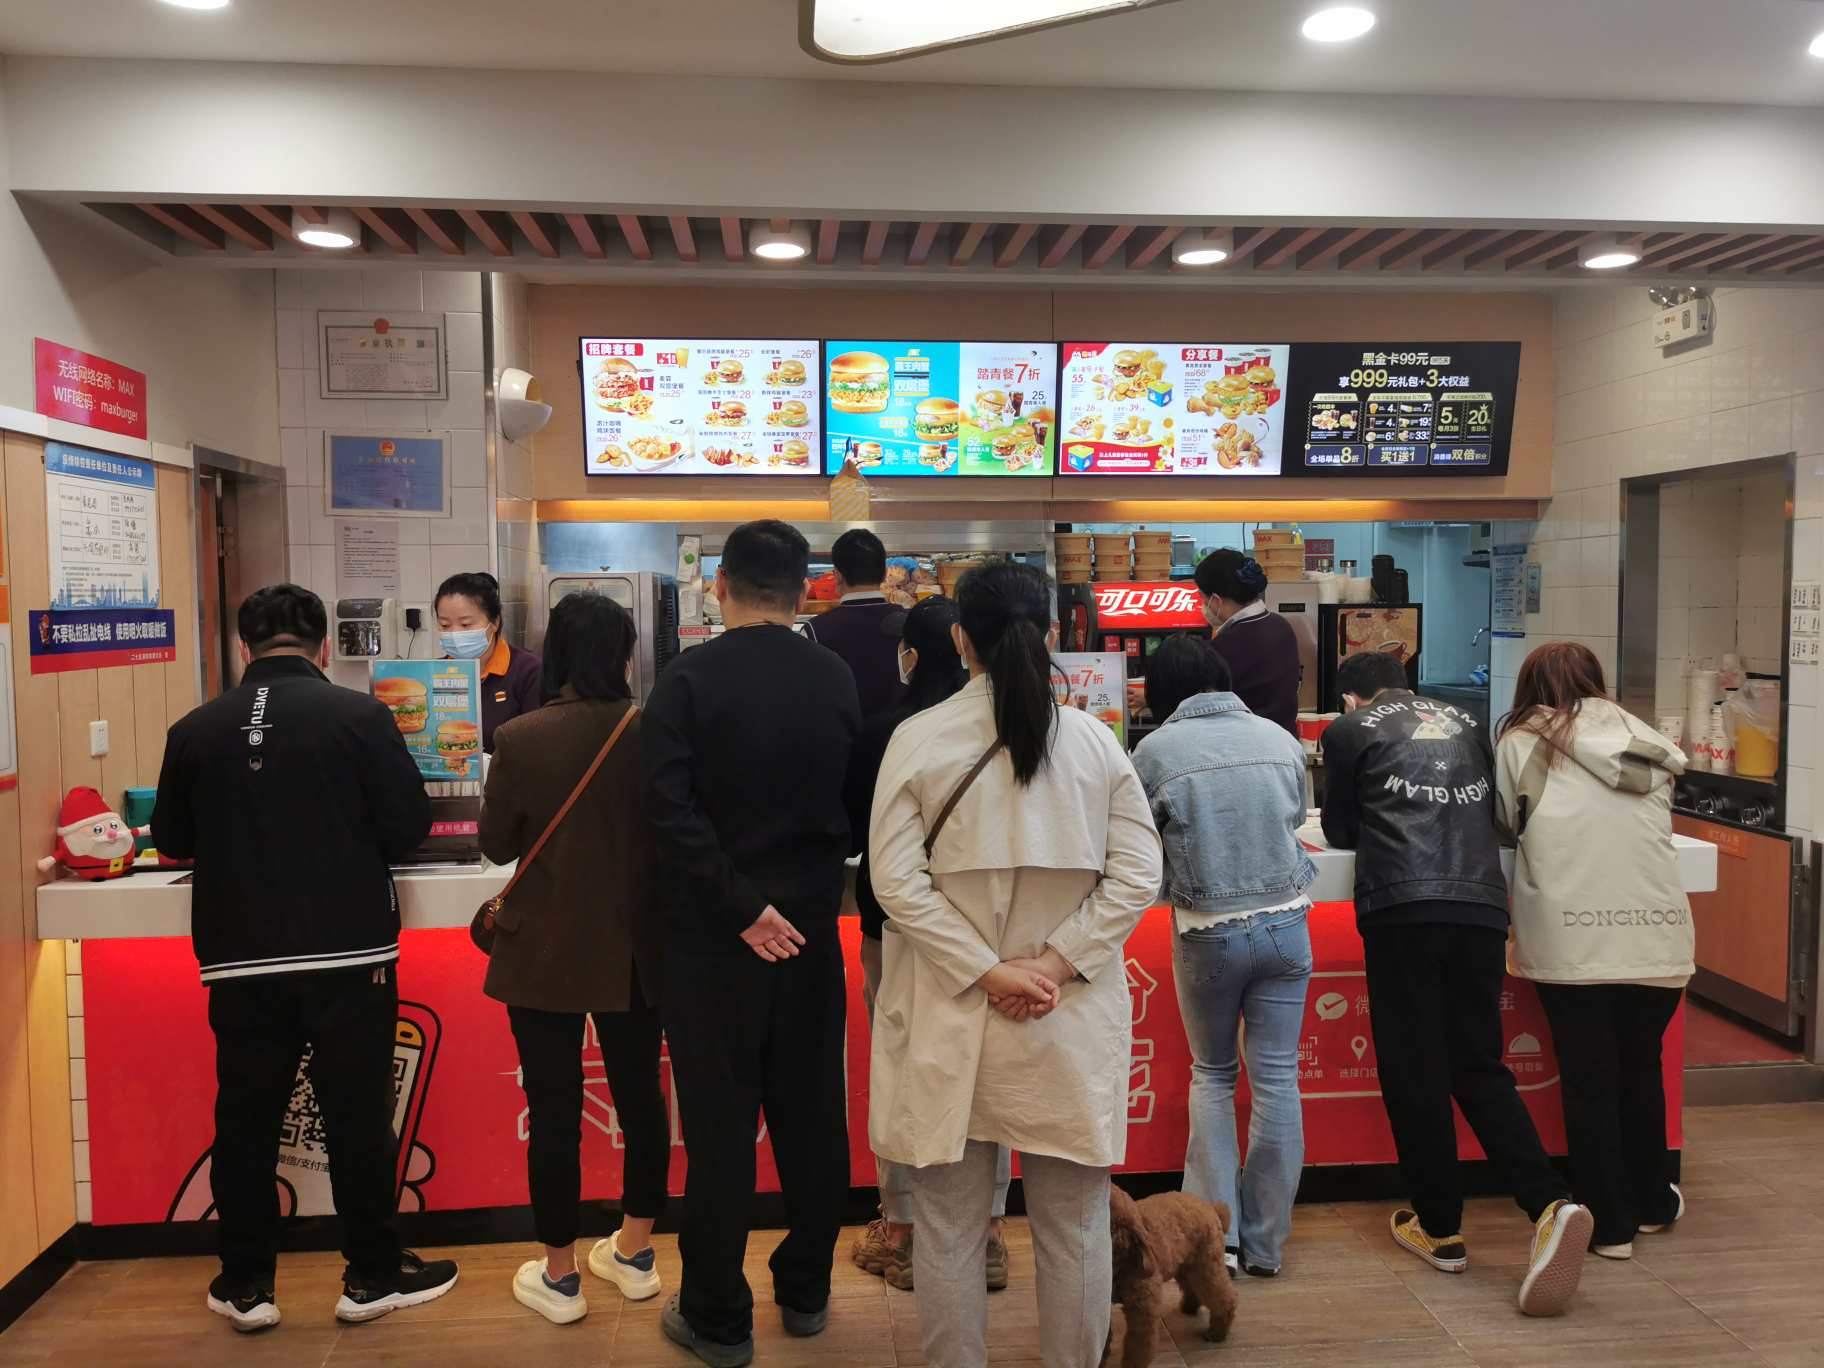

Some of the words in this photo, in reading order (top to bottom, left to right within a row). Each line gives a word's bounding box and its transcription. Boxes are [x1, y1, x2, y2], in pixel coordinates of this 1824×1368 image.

[1185, 349, 1219, 361] 分享餐
[1362, 352, 1428, 366] 黑金卡99元
[58, 360, 115, 391] 无线网络名称：
[118, 379, 135, 397] MAX
[977, 363, 1040, 384] 踏青餐7折
[1338, 368, 1470, 388] 享999元礼包+3大权益
[53, 385, 97, 412] WIFI密码：
[100, 401, 138, 426] maxburger
[1381, 452, 1415, 463] 买1送1
[1096, 587, 1200, 613] 可口可乐
[52, 623, 111, 644] 不要私拉乱扯电线
[115, 621, 167, 641] 使用明火取暖做饭
[1361, 701, 1410, 729] HIGH
[1411, 701, 1478, 728] GLAM
[1383, 774, 1449, 804] GLAM
[1453, 776, 1490, 805] HIGH
[1562, 909, 1688, 927] DONGKOON
